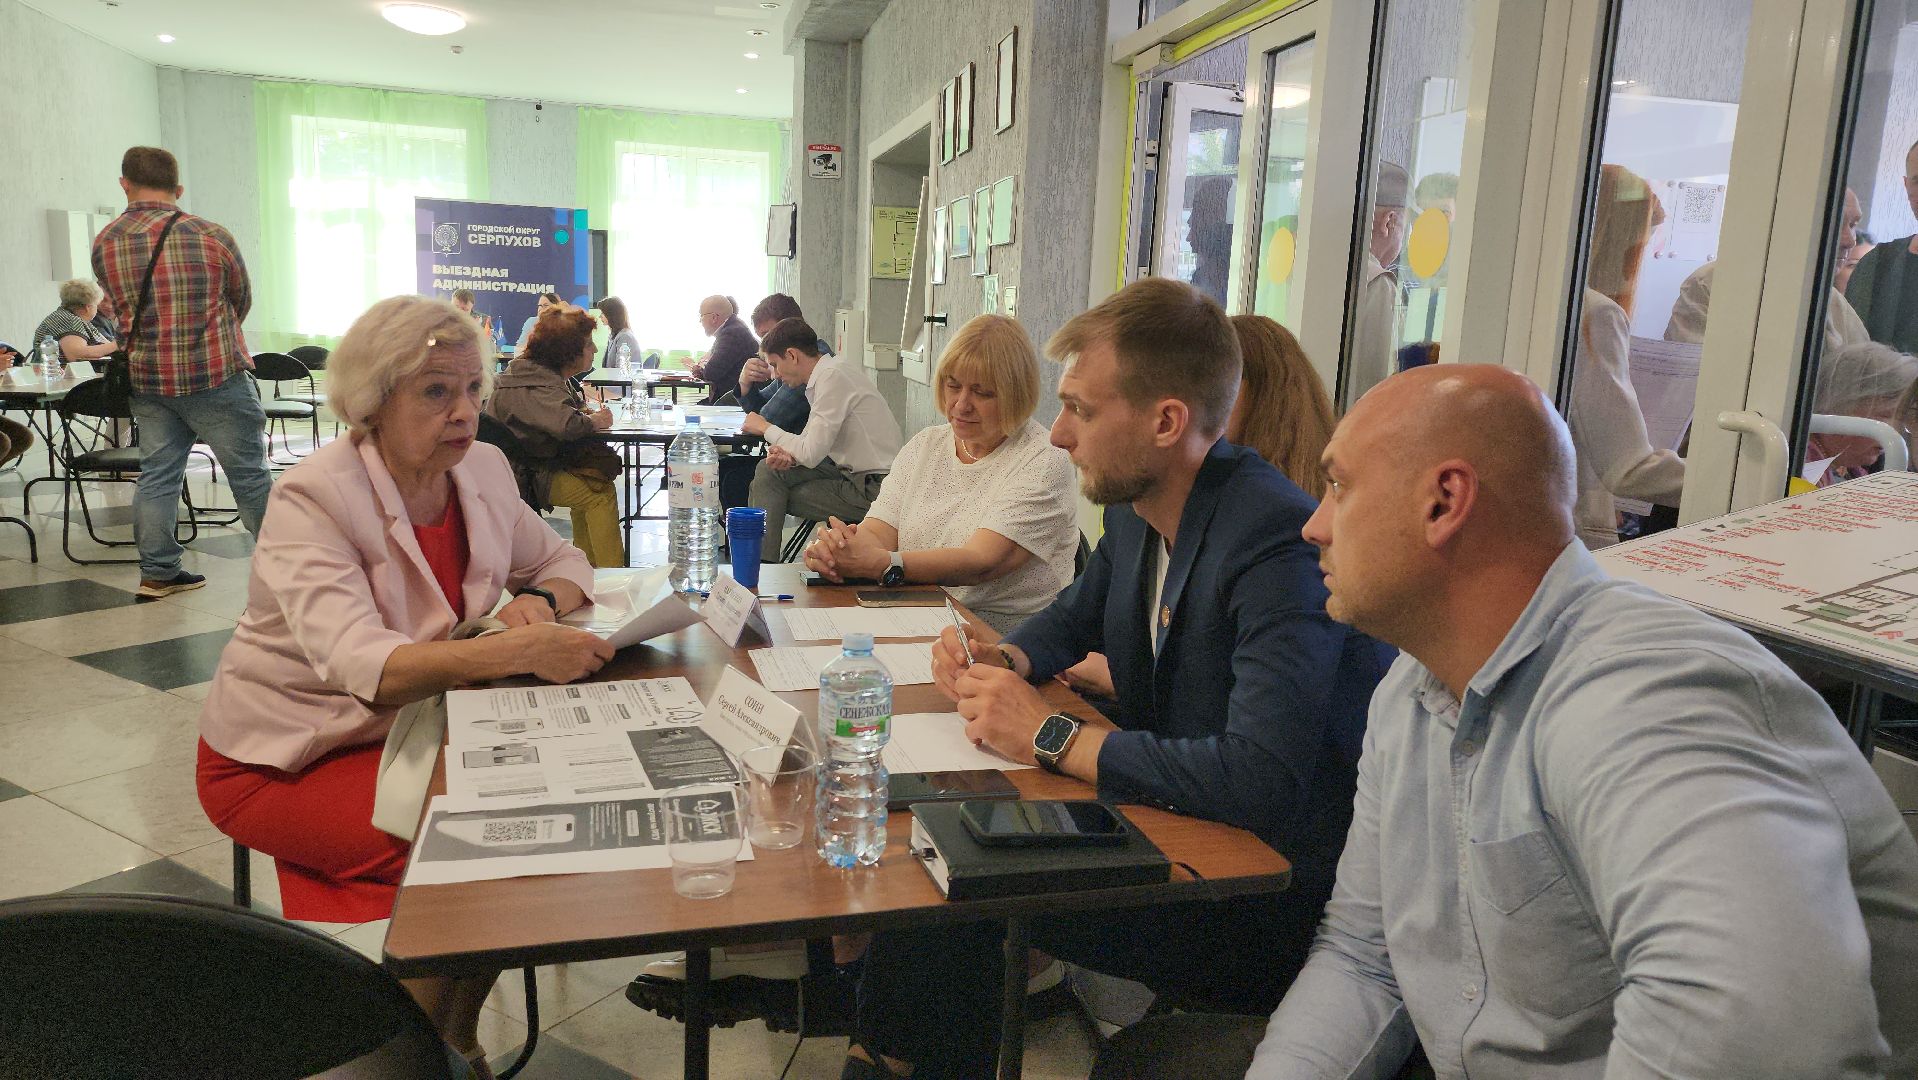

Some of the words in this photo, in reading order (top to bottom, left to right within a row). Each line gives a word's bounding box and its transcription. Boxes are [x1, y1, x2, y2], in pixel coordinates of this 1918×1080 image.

[467, 224, 515, 234] ГОРОДСКОЙ
[516, 227, 541, 235] ОКРУГ
[468, 234, 542, 248] СЕРПУХОВ
[432, 264, 509, 278] ВЫЕЗДНАЯ
[432, 279, 555, 294] АДМИНИСТРАЦИЯ
[718, 694, 738, 714] Сергей
[734, 707, 781, 744] Александрович
